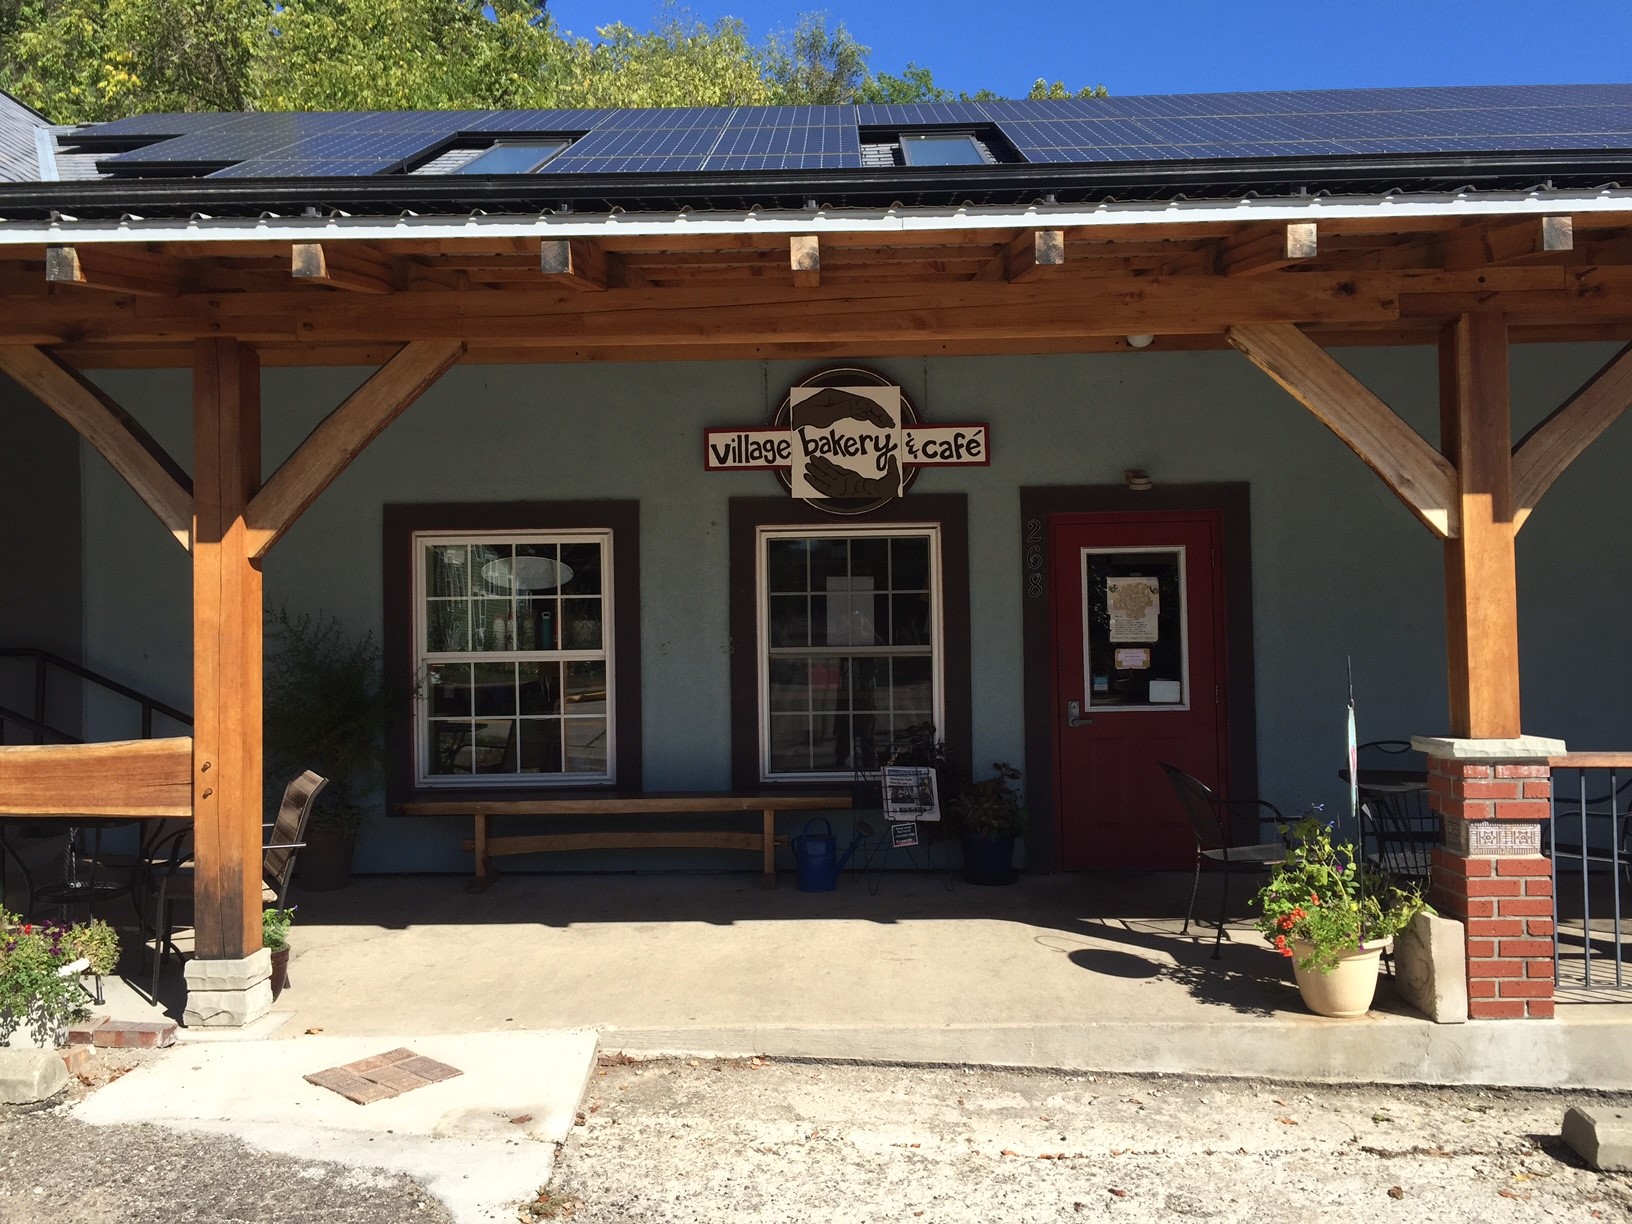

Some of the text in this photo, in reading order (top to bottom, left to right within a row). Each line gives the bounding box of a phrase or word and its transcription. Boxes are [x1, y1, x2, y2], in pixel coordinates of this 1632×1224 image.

[798, 426, 898, 472] bakery
[905, 432, 919, 460] &
[921, 429, 983, 460] café
[1026, 518, 1043, 598] 268
